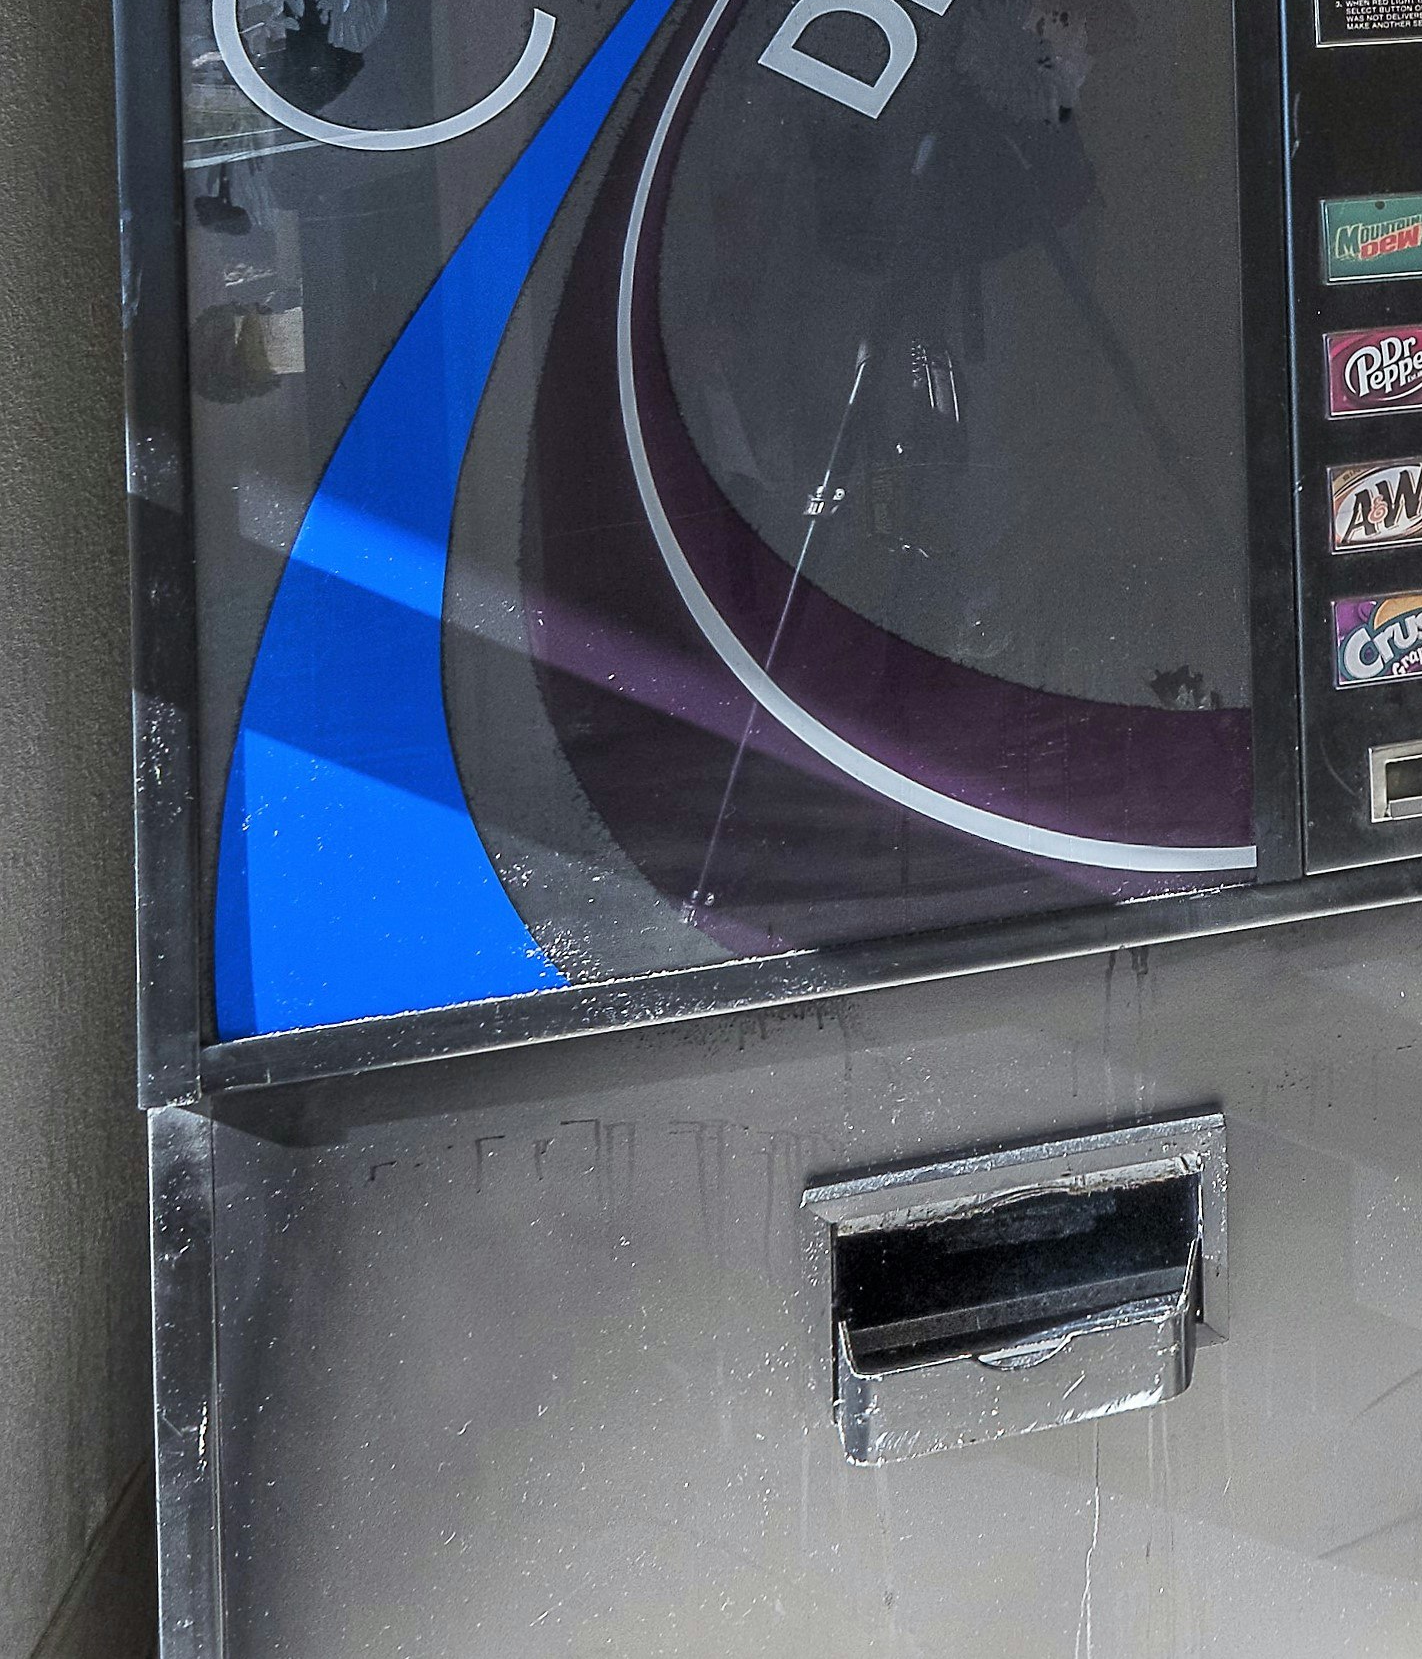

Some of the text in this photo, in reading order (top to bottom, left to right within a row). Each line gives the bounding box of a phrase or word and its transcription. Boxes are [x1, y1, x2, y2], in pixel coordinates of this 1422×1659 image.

[1345, 0, 1369, 7] WHEN
[1346, 7, 1376, 15] SELECT
[1379, 5, 1413, 14] BUTTON
[1346, 15, 1364, 23] WAS
[1367, 14, 1384, 22] NOT
[1346, 22, 1370, 30] MAKE
[1372, 20, 1411, 29] ANOTHER
[1380, 337, 1416, 368] Dr
